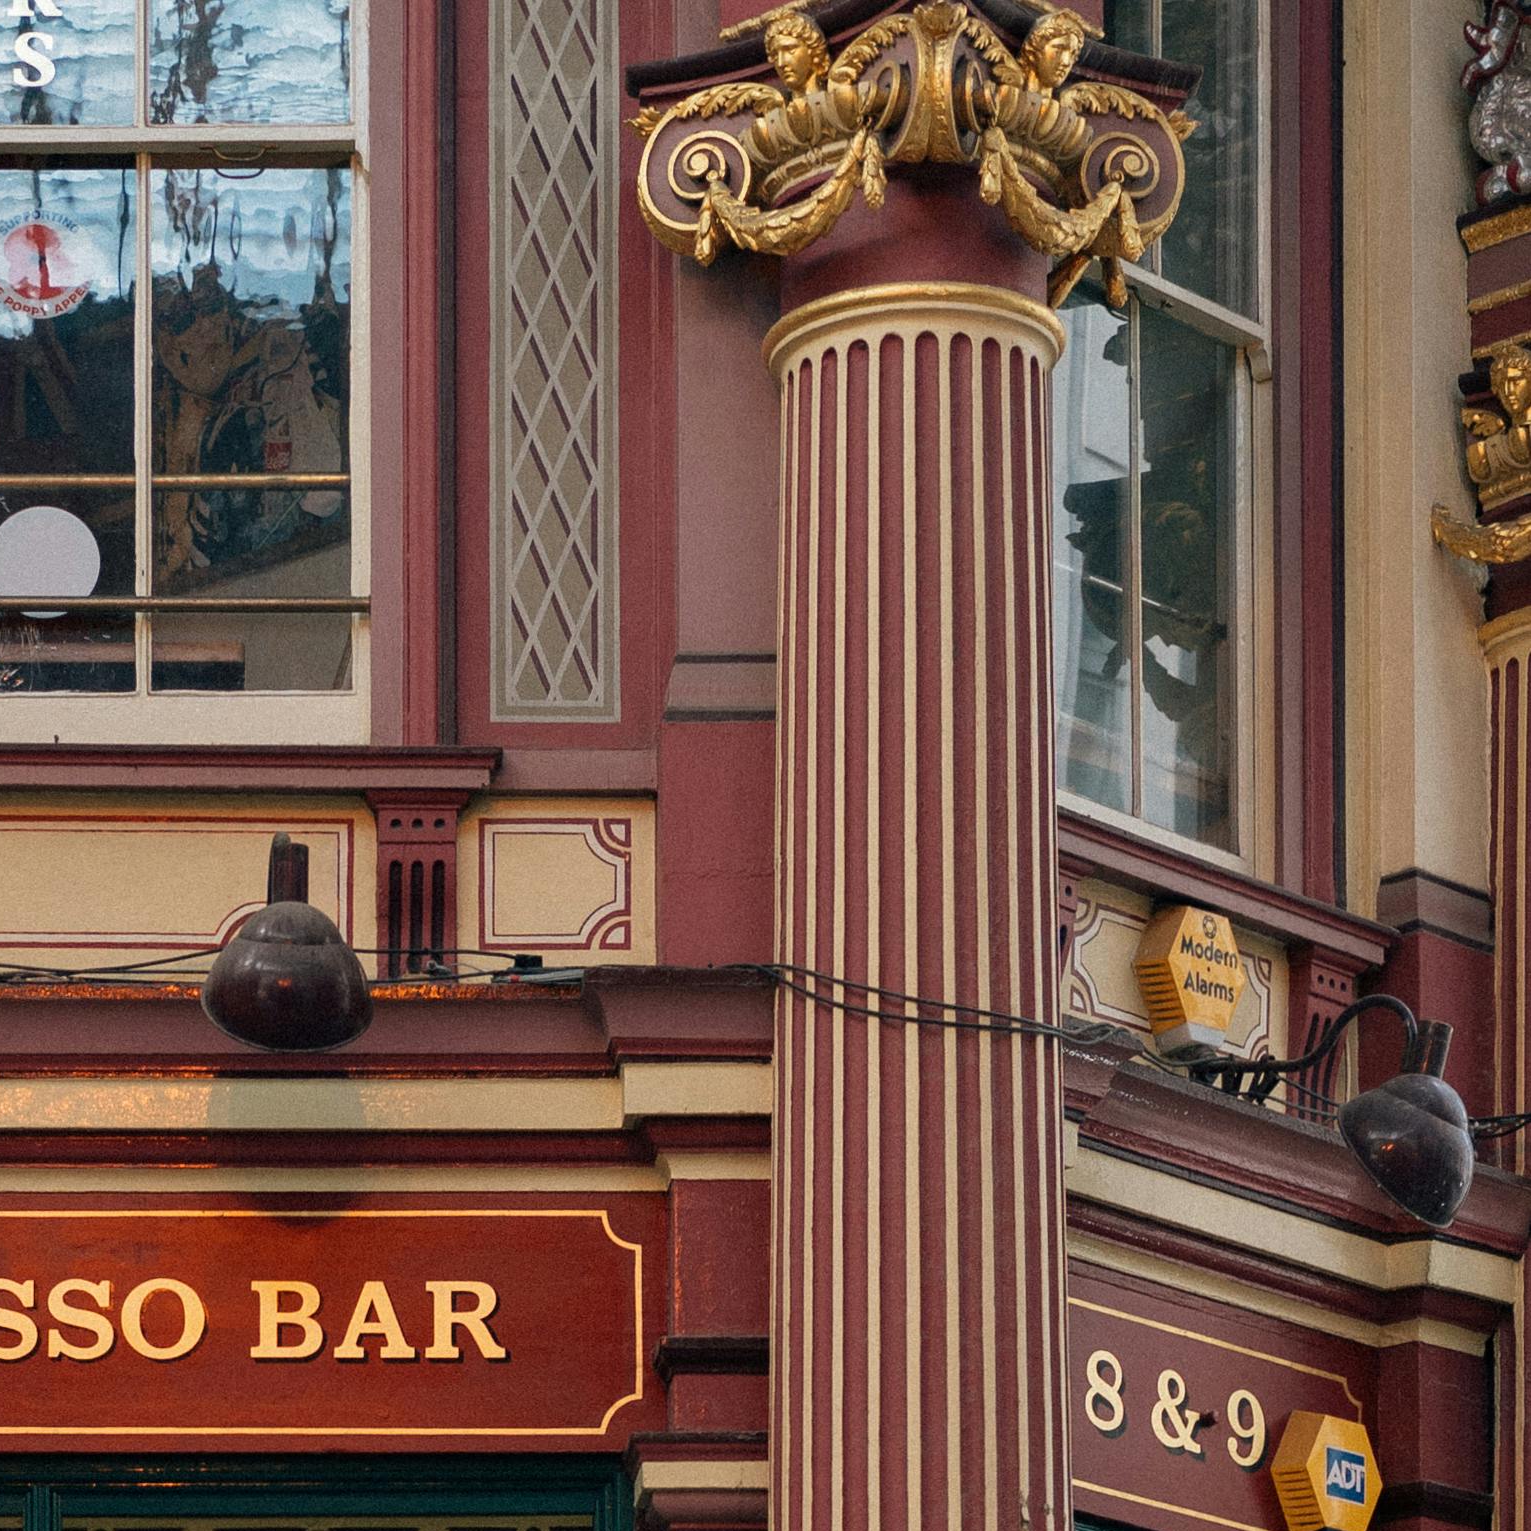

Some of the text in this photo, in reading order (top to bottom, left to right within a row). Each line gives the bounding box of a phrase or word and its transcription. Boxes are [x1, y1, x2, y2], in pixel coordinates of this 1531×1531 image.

[4, 296, 47, 316] POPPY
[1180, 933, 1238, 969] Modern
[1183, 970, 1235, 1004] Alarms
[249, 1280, 508, 1361] BAR
[1084, 1349, 1267, 1468] 8 & 9
[1326, 1458, 1366, 1494] ADT
